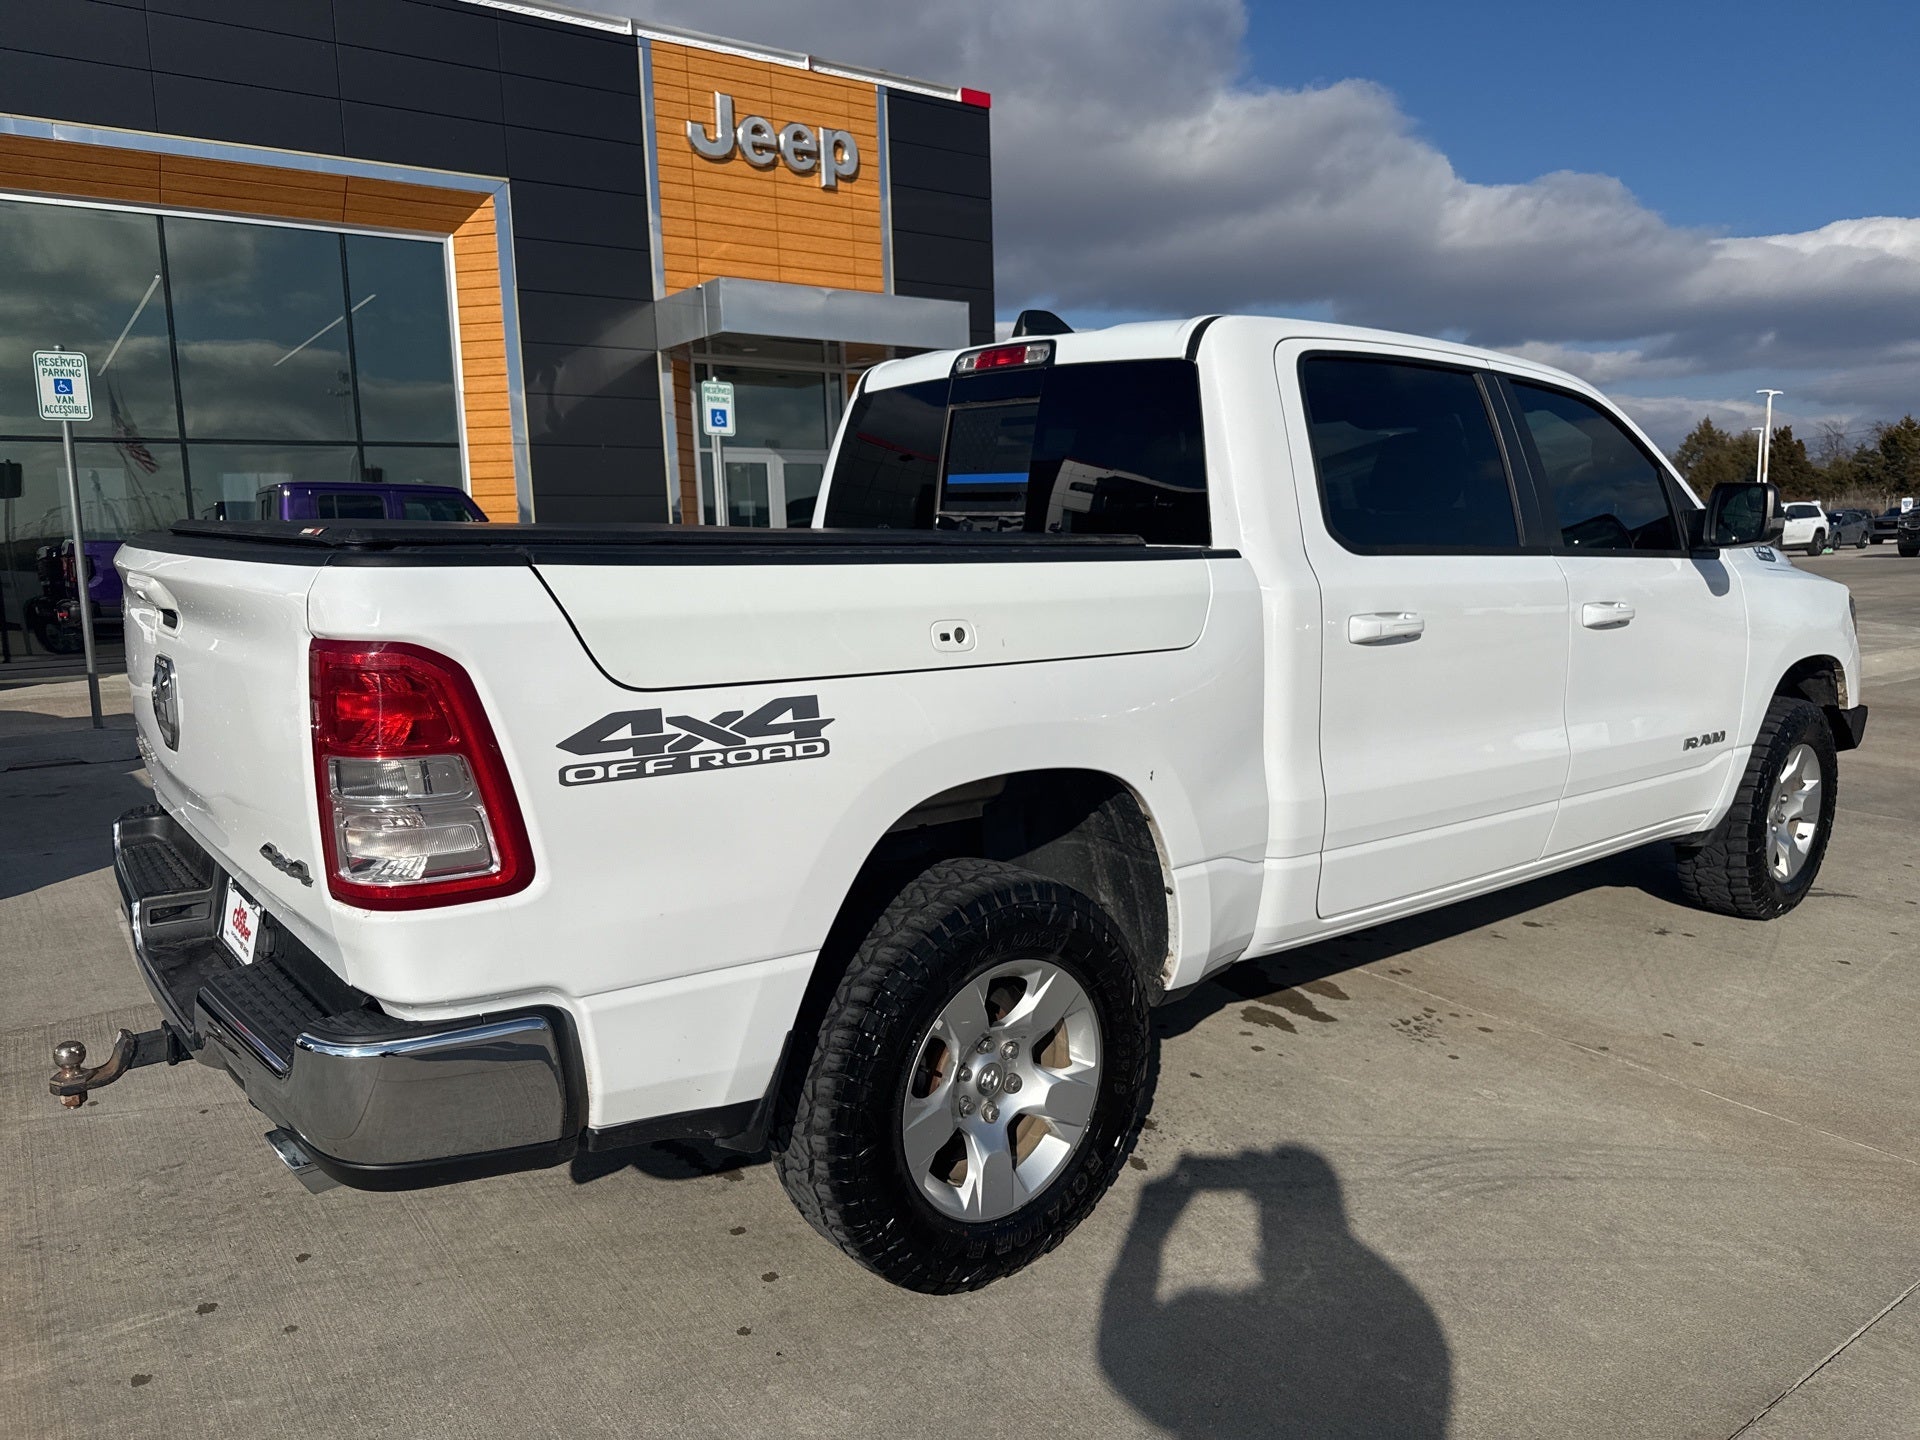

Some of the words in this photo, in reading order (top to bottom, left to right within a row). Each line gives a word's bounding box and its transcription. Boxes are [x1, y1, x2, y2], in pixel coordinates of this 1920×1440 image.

[686, 91, 858, 189] Jeep
[38, 357, 82, 368] RESERVED
[42, 368, 82, 378] PARKING
[55, 396, 75, 404] VAN
[44, 405, 88, 414] ACCESSIBLE
[1683, 730, 1726, 751] RAM
[565, 756, 678, 783] OFF
[690, 741, 826, 769] ROAD
